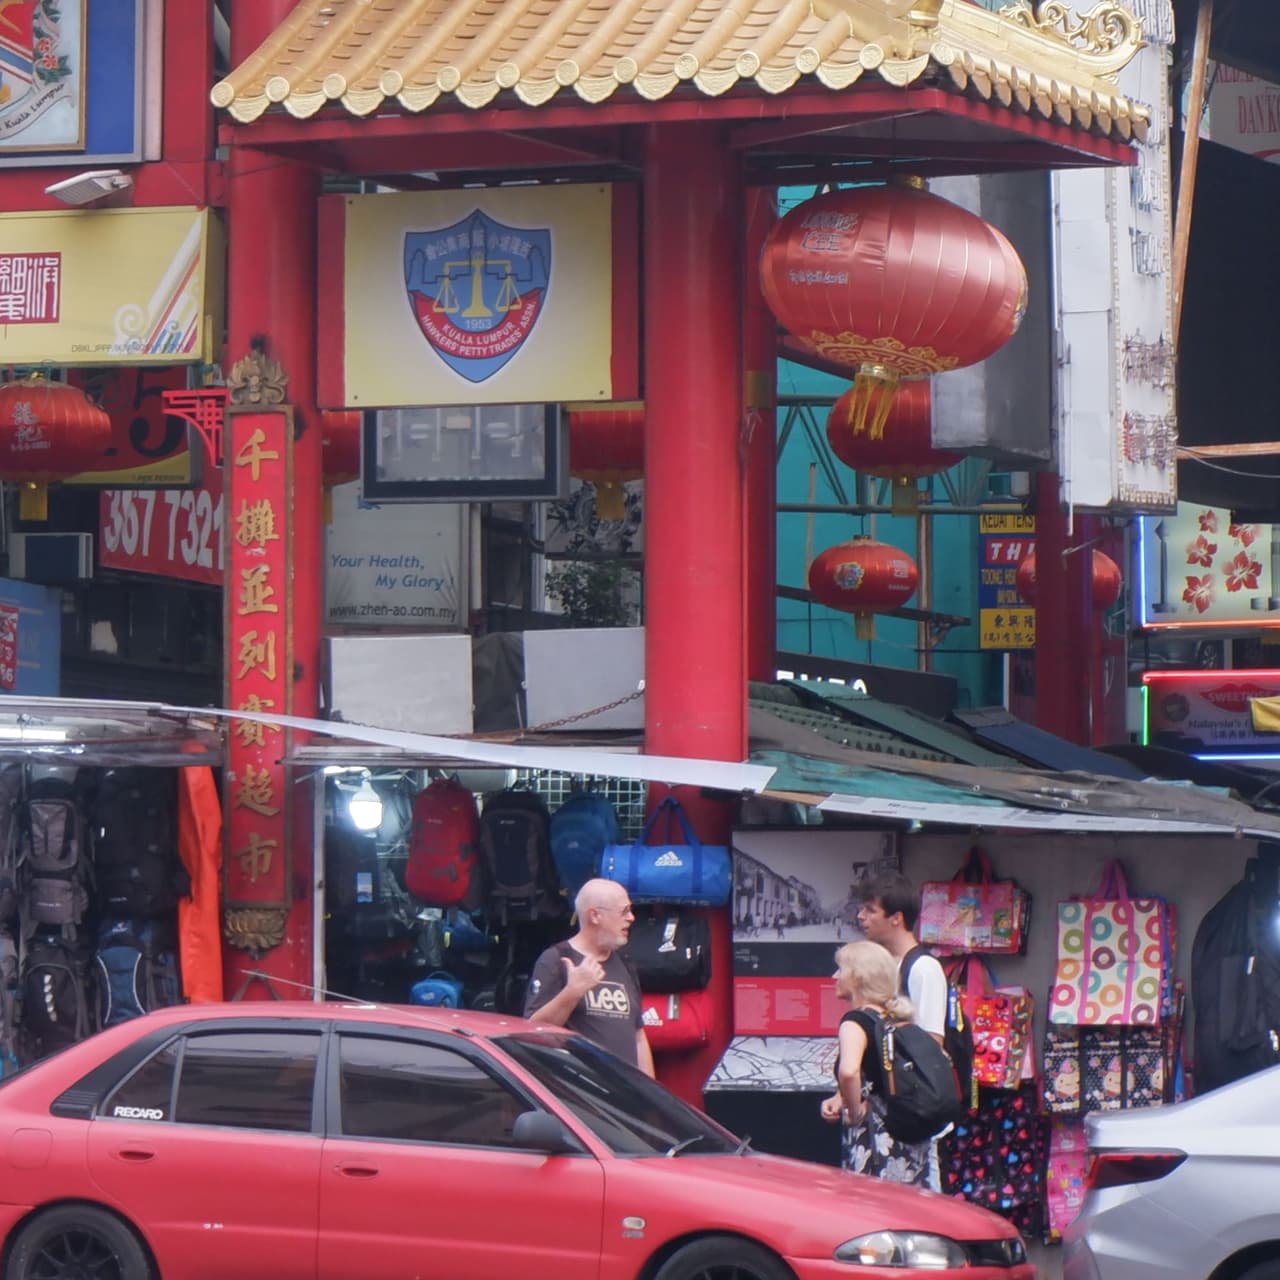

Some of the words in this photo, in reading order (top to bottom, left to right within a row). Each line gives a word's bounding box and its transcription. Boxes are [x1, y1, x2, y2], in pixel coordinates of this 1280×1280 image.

[332, 554, 365, 568] Your
[369, 554, 425, 570] Health,
[376, 574, 397, 589] My
[402, 574, 445, 591] Glory
[589, 987, 628, 1011] Lee
[114, 1106, 163, 1120] RECARO
